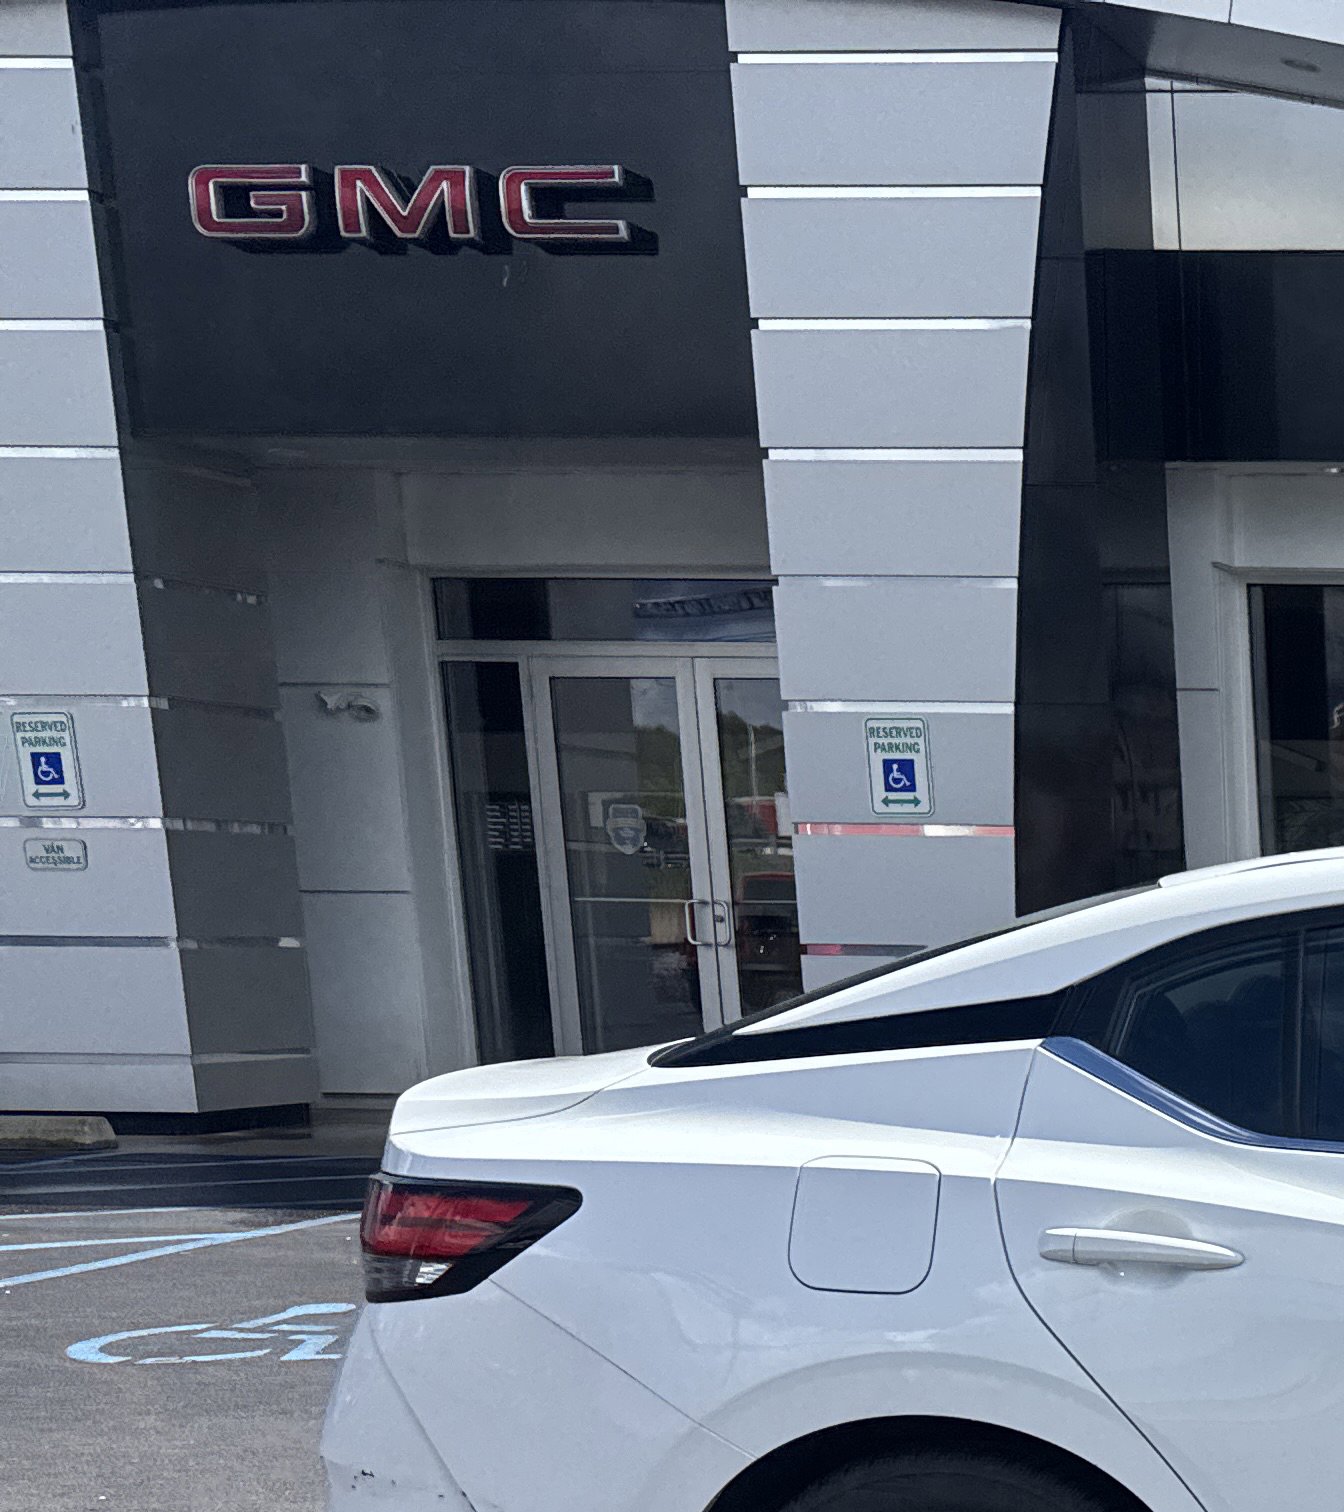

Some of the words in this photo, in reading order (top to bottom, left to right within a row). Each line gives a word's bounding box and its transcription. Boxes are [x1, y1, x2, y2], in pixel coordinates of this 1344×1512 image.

[188, 163, 629, 243] GMC
[15, 720, 67, 733] RESERVED
[868, 726, 922, 738] RESERVED
[20, 735, 67, 747] PARKING
[873, 741, 921, 753] PARKING
[42, 843, 65, 854] VAN
[29, 855, 83, 865] ACCESSIBLE
